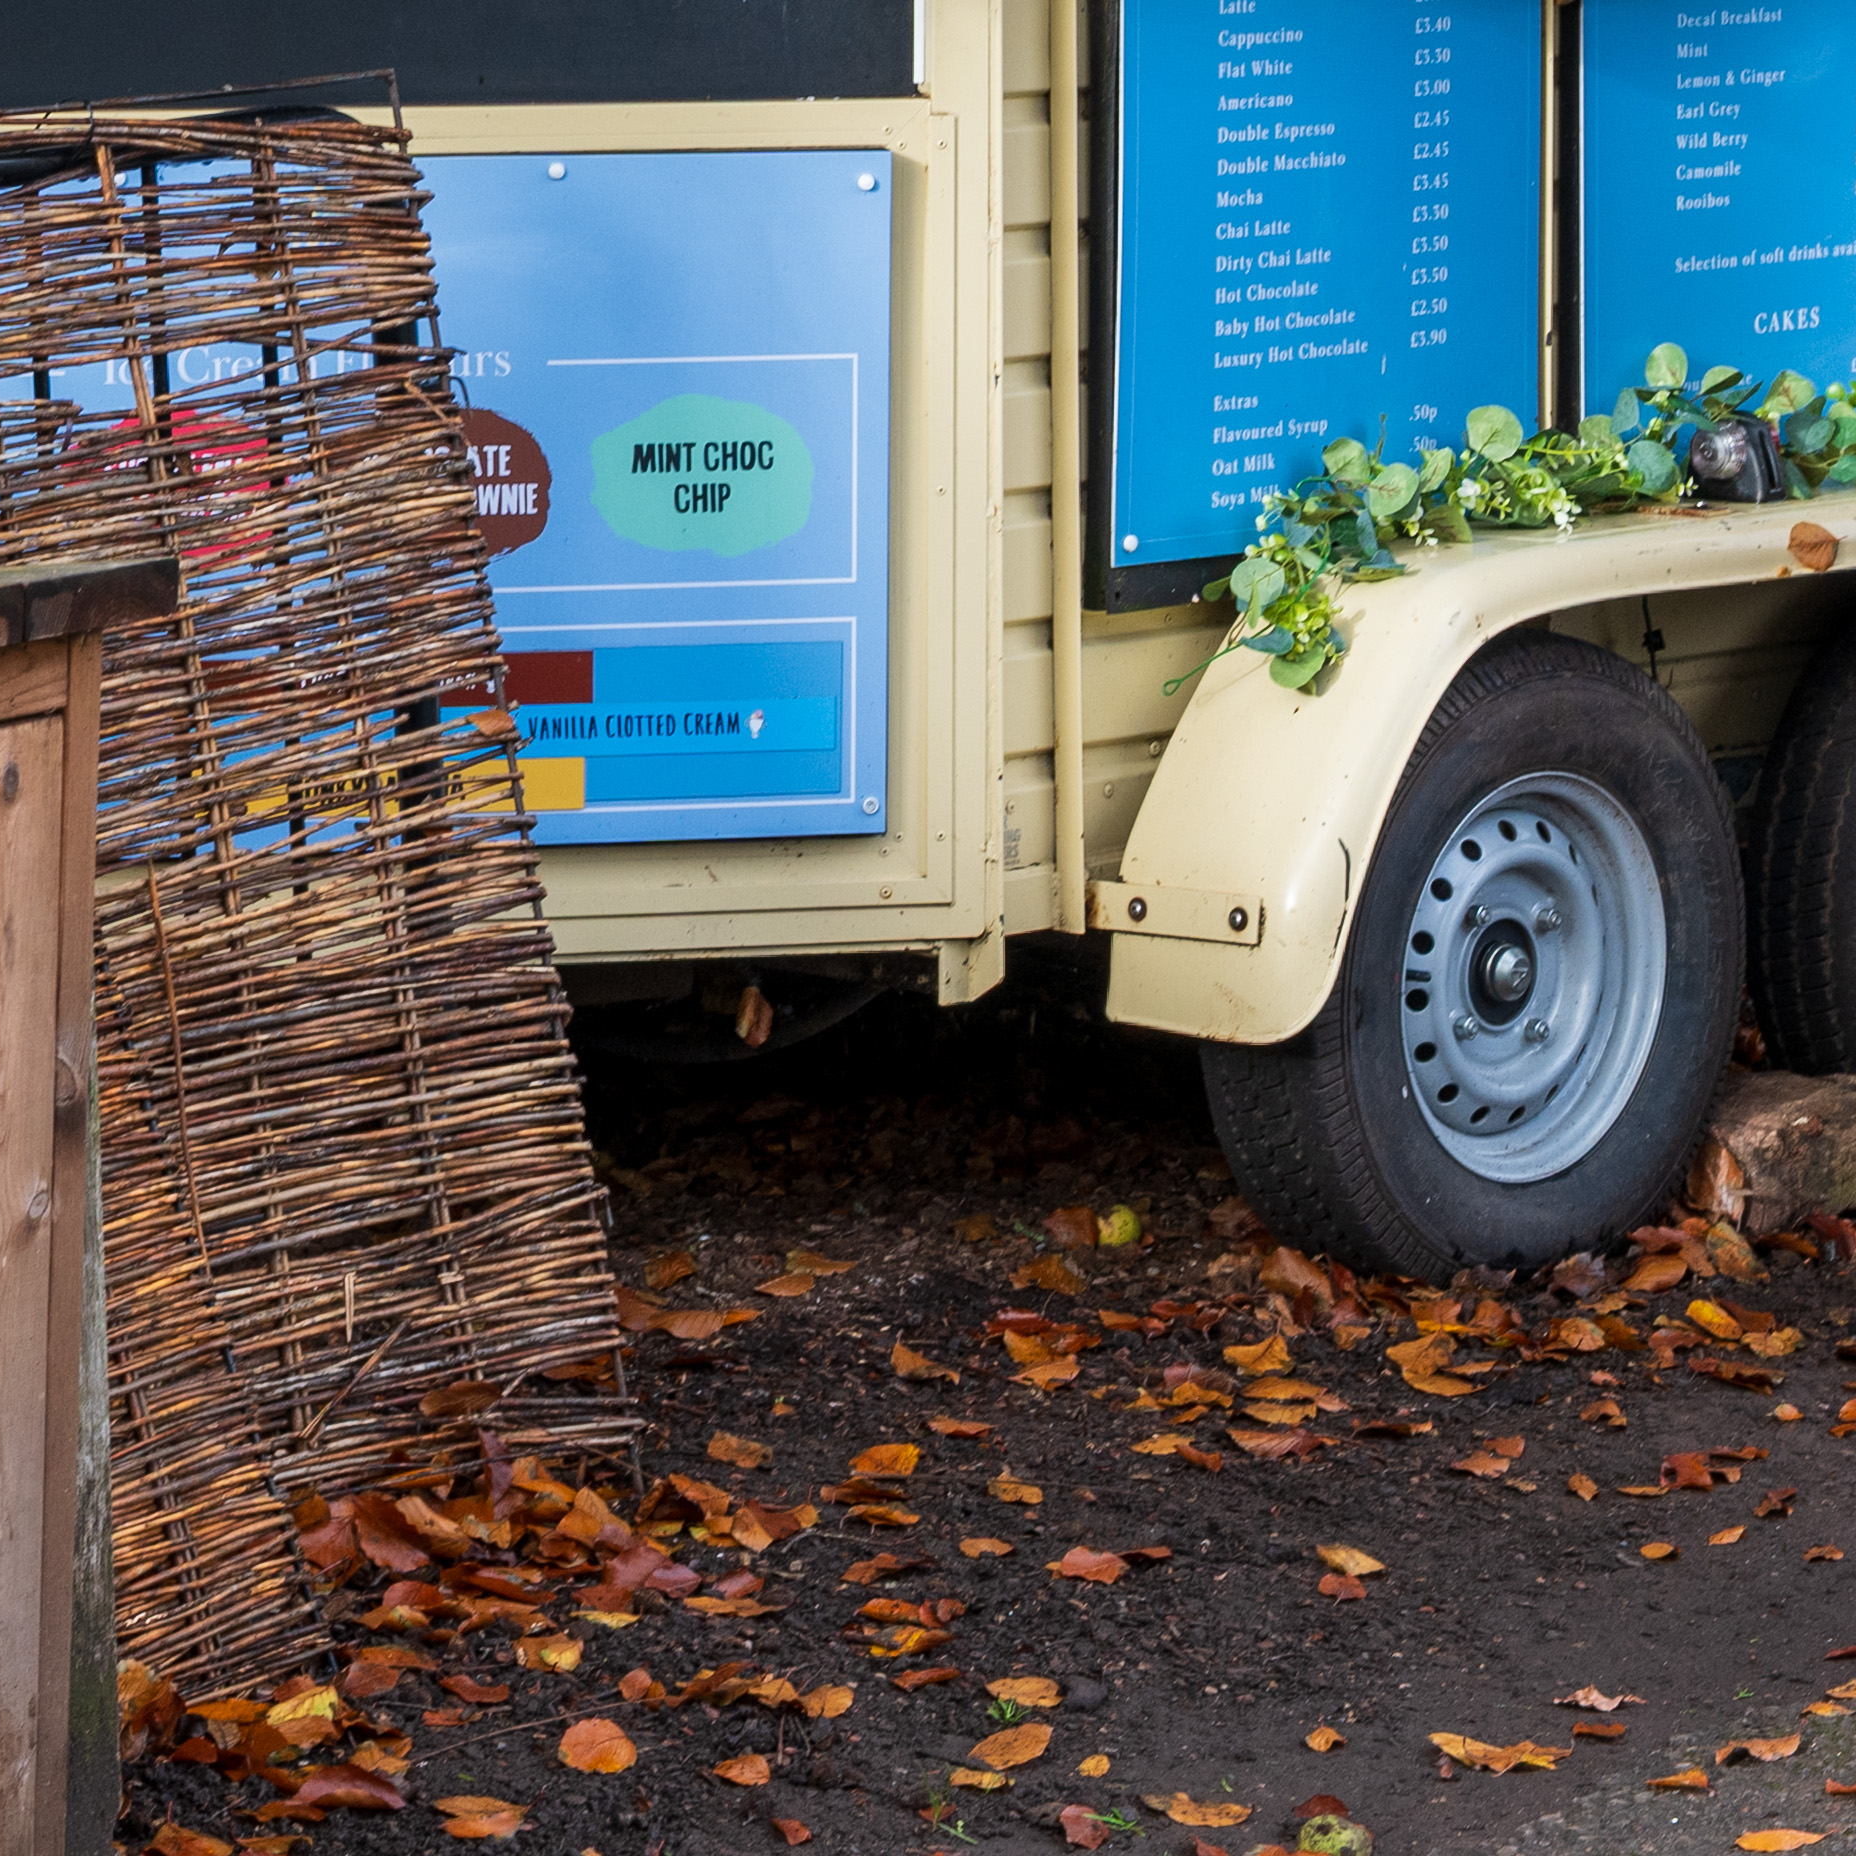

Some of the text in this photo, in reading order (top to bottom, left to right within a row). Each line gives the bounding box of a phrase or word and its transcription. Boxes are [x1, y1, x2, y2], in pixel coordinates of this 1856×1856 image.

[1217, 15, 1452, 51] Cappuccino £3.40
[1677, 10, 1716, 29] Decaf
[1720, 7, 1782, 26] Breakfast
[1218, 47, 1451, 79] Flat White £3.30
[1676, 43, 1708, 59] Mint
[1217, 78, 1451, 112] Americano £3.00
[1676, 73, 1721, 90] Lemon
[1724, 70, 1735, 86] &
[1739, 68, 1786, 88] Ginger
[1217, 109, 1450, 144] Double Espresso £2.45
[1676, 101, 1705, 120] Earl
[1708, 101, 1741, 120] Grey
[1676, 132, 1708, 150] Wild
[1712, 131, 1749, 150] Berry
[1217, 140, 1449, 177] Double Macchiato £2.45
[1675, 159, 1742, 181] Camomile
[1216, 172, 1449, 208] Mocha £3.45
[1676, 191, 1731, 211] Rooibos
[1215, 203, 1450, 241] Chai Latte £3.30
[1215, 235, 1449, 275] Dirty Chai Latte £3.50
[1674, 253, 1738, 273] Selection
[1741, 248, 1757, 267] of
[1759, 246, 1785, 265] soft
[1787, 242, 1830, 262] drinks
[1215, 266, 1449, 305] Hot Chocolate £3.50
[1214, 297, 1448, 339] Baby Hot Chocolate £2.50
[1753, 305, 1821, 335] CAKES
[1214, 328, 1448, 370] Luxury Hot Chocolate £3.90
[1213, 394, 1259, 413] Extras
[1212, 404, 1438, 445] Flavoured Syrup .50p
[631, 440, 775, 474] MINT CHOC
[1211, 458, 1239, 477] Oat
[1243, 452, 1276, 473] Milk
[673, 482, 732, 514] CHIP
[1210, 490, 1246, 511] Soya
[528, 711, 741, 741] VANILLA CLOTTED CREAM
